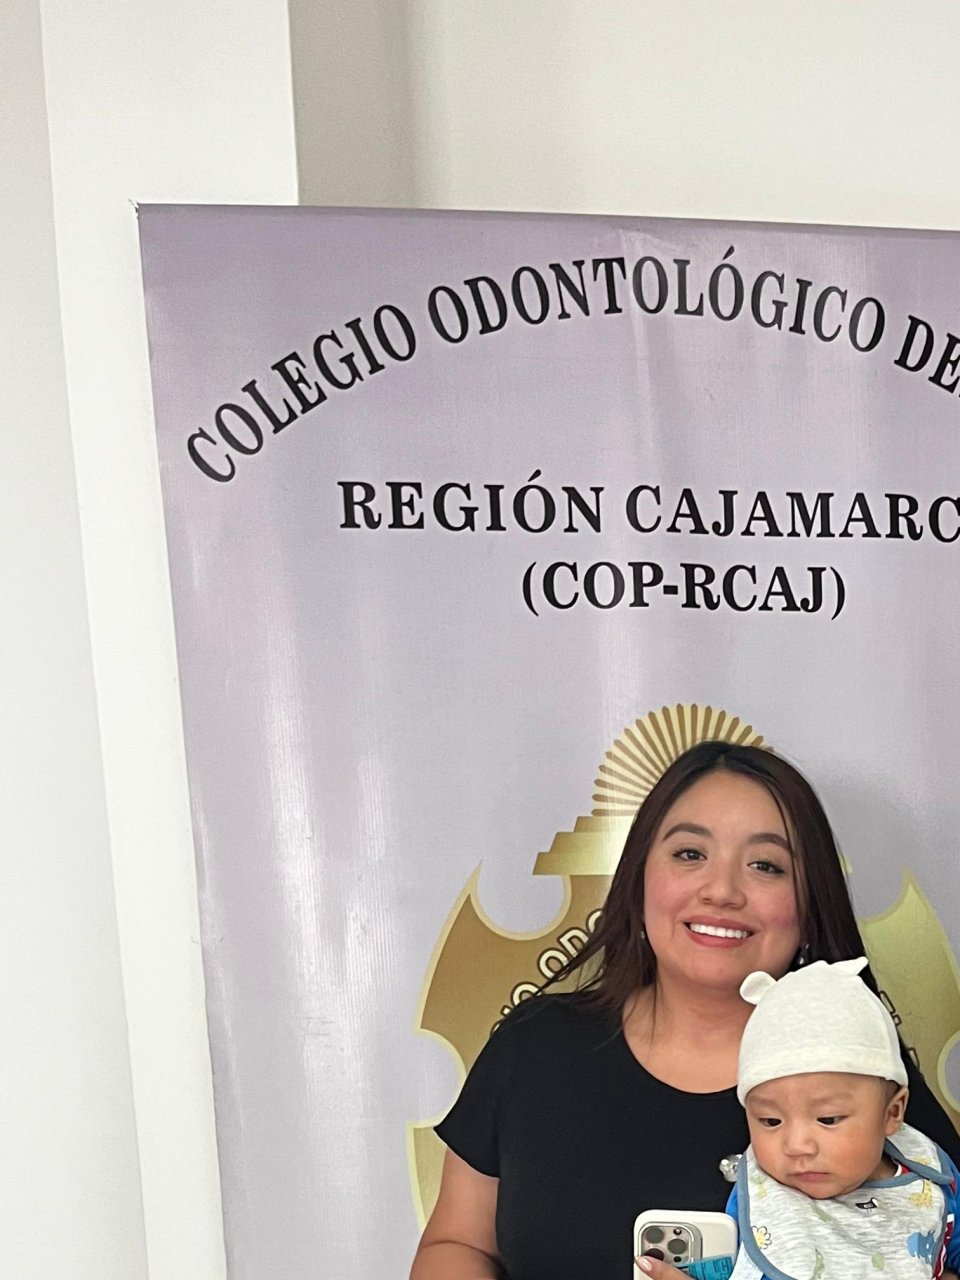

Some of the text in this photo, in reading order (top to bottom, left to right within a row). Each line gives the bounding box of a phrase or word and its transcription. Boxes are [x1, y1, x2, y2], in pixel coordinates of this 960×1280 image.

[187, 304, 416, 483] COLEGIO
[427, 246, 885, 352] ODONTOLÓGICO
[337, 469, 604, 534] REGIÓN
[522, 561, 846, 620] (COP-RCAJ)
